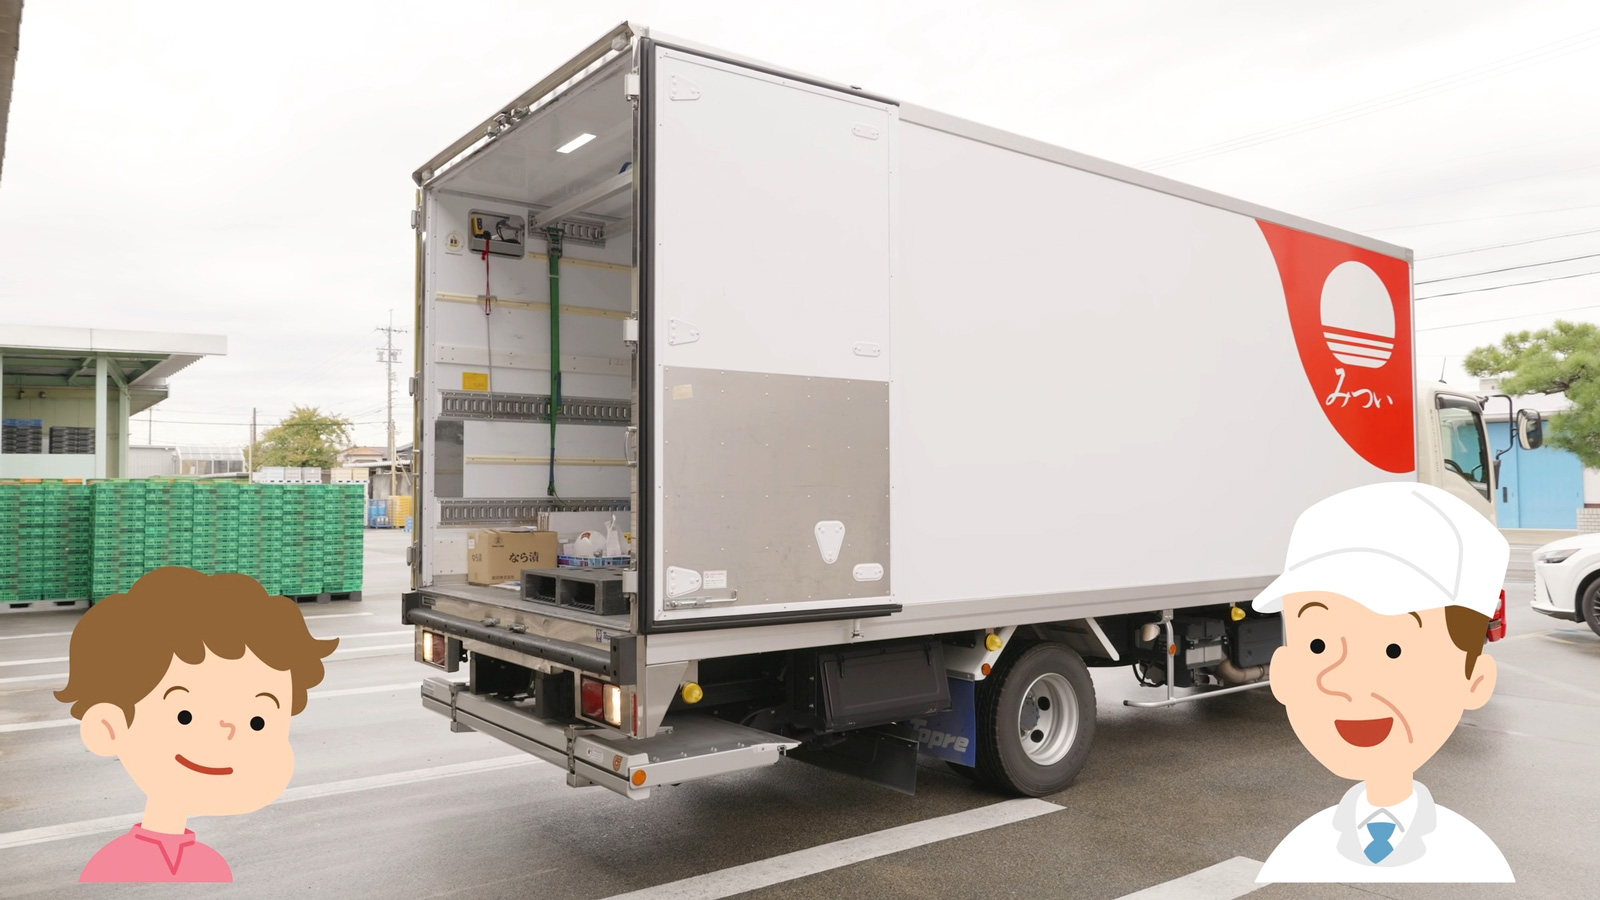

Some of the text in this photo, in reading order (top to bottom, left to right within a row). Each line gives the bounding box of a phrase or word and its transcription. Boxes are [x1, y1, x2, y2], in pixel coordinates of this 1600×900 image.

[1325, 367, 1394, 409] みつい
[603, 631, 611, 641] Top
[910, 717, 970, 753] Topre
